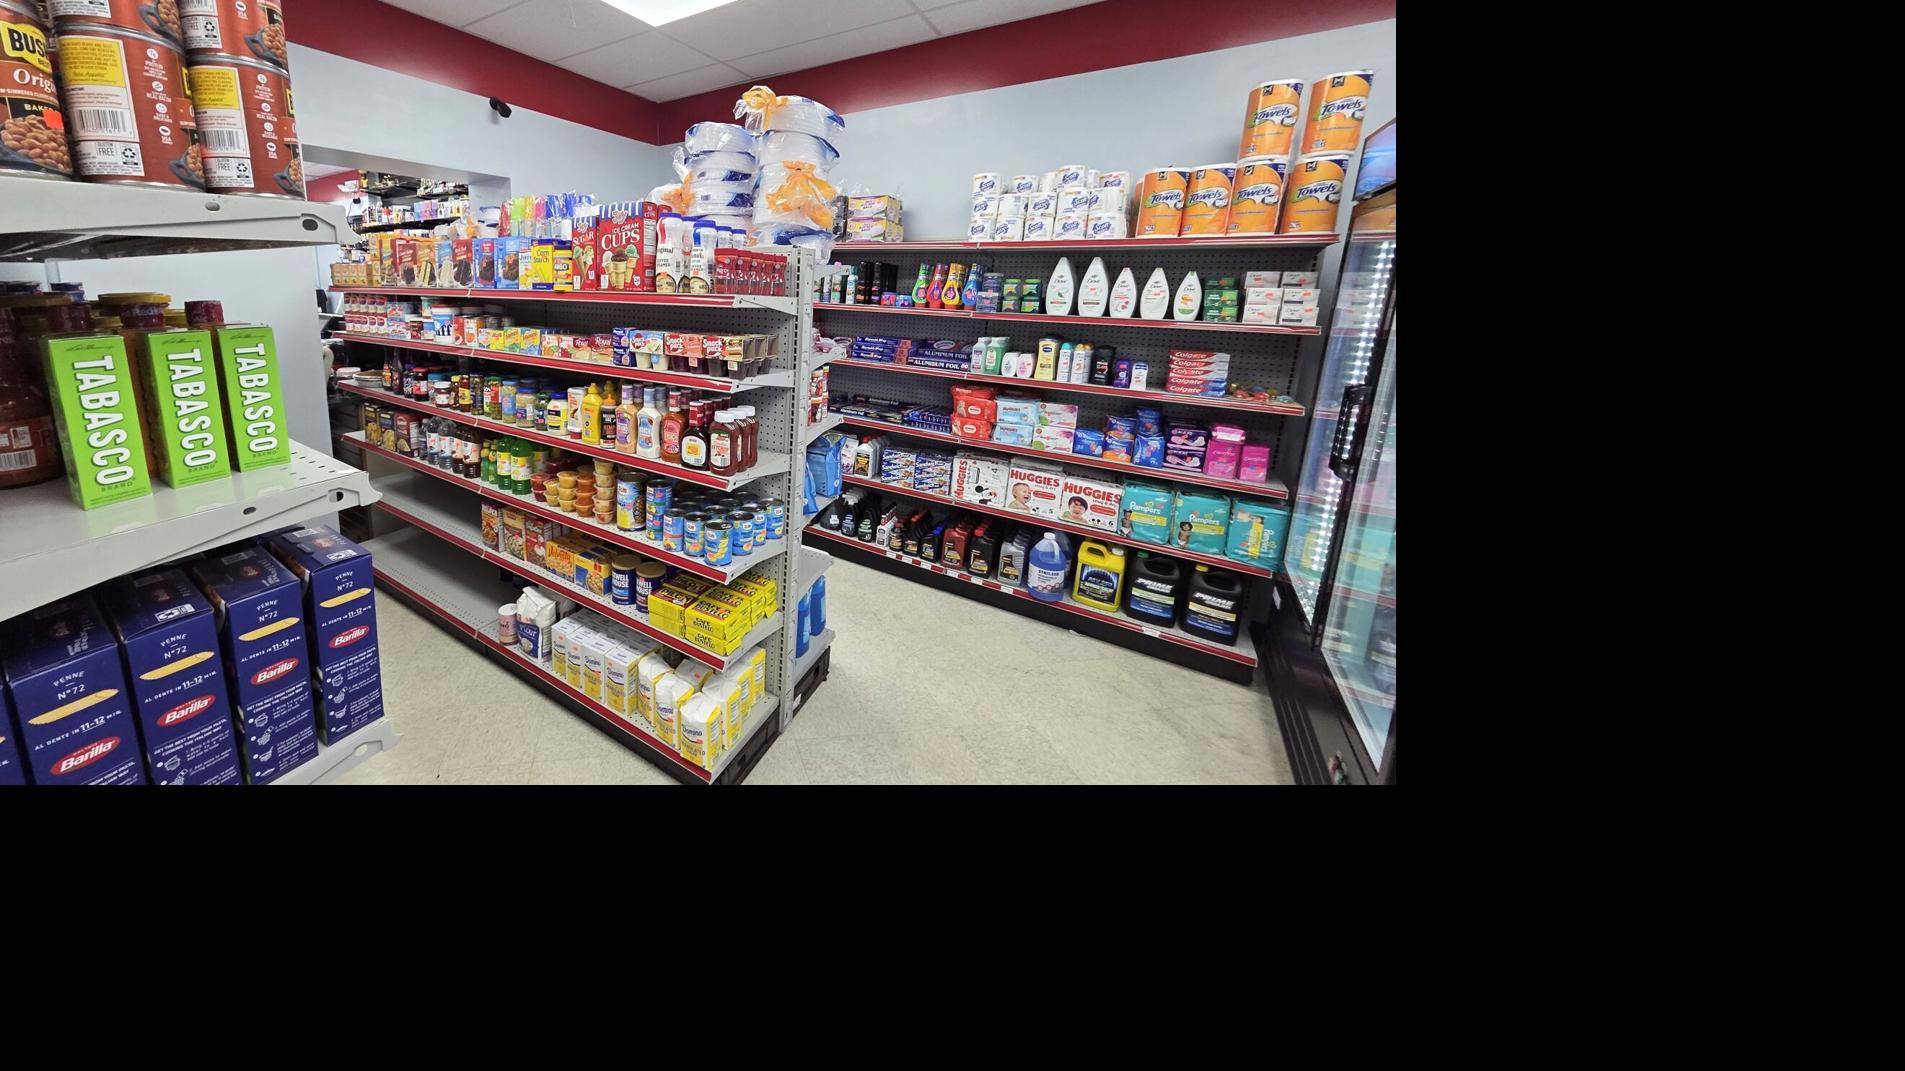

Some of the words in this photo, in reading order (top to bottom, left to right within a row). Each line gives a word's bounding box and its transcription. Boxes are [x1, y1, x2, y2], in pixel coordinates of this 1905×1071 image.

[8, 28, 46, 58] BUS
[14, 68, 56, 93] Origi
[1254, 106, 1290, 120] Towels
[1321, 100, 1361, 116] Towels
[99, 148, 114, 156] FREE
[1190, 190, 1222, 202] Towels
[1238, 186, 1272, 199] Towels
[1297, 183, 1336, 198] Towels
[1152, 192, 1181, 204] Towels
[620, 222, 639, 232] CREAM
[572, 232, 594, 246] SUGAR
[602, 228, 640, 250] CUPS
[666, 336, 684, 346] Snack
[703, 339, 722, 348] Snack
[914, 360, 945, 368] ALUMINUM
[235, 343, 278, 453] TABASCO
[167, 348, 217, 468] TABASCO
[72, 355, 136, 486] TABASCO
[954, 460, 968, 500] HUGGIES
[1010, 470, 1060, 488] HUGGIES
[101, 482, 133, 492] BRAND
[1064, 482, 1122, 504] HUGGIES
[1130, 500, 1160, 514] Pampers
[1189, 514, 1220, 526] Pampers
[336, 571, 354, 580] PENNE
[1136, 578, 1174, 590] PRIME
[256, 600, 278, 610] PENNE
[1194, 592, 1236, 606] PRIME
[348, 608, 362, 618] 11-12
[160, 634, 187, 647] PENNE
[334, 628, 365, 646] Barilla
[272, 639, 290, 651] 11-12
[53, 671, 85, 686] PENNE
[256, 662, 294, 683] Barilla
[154, 688, 173, 700] DENTE
[182, 676, 203, 688] 11-12
[164, 698, 209, 724] Barilla
[46, 732, 70, 746] DENTE
[80, 716, 105, 731] 11-12
[682, 724, 702, 736] Domino
[60, 742, 113, 772] Barilla
